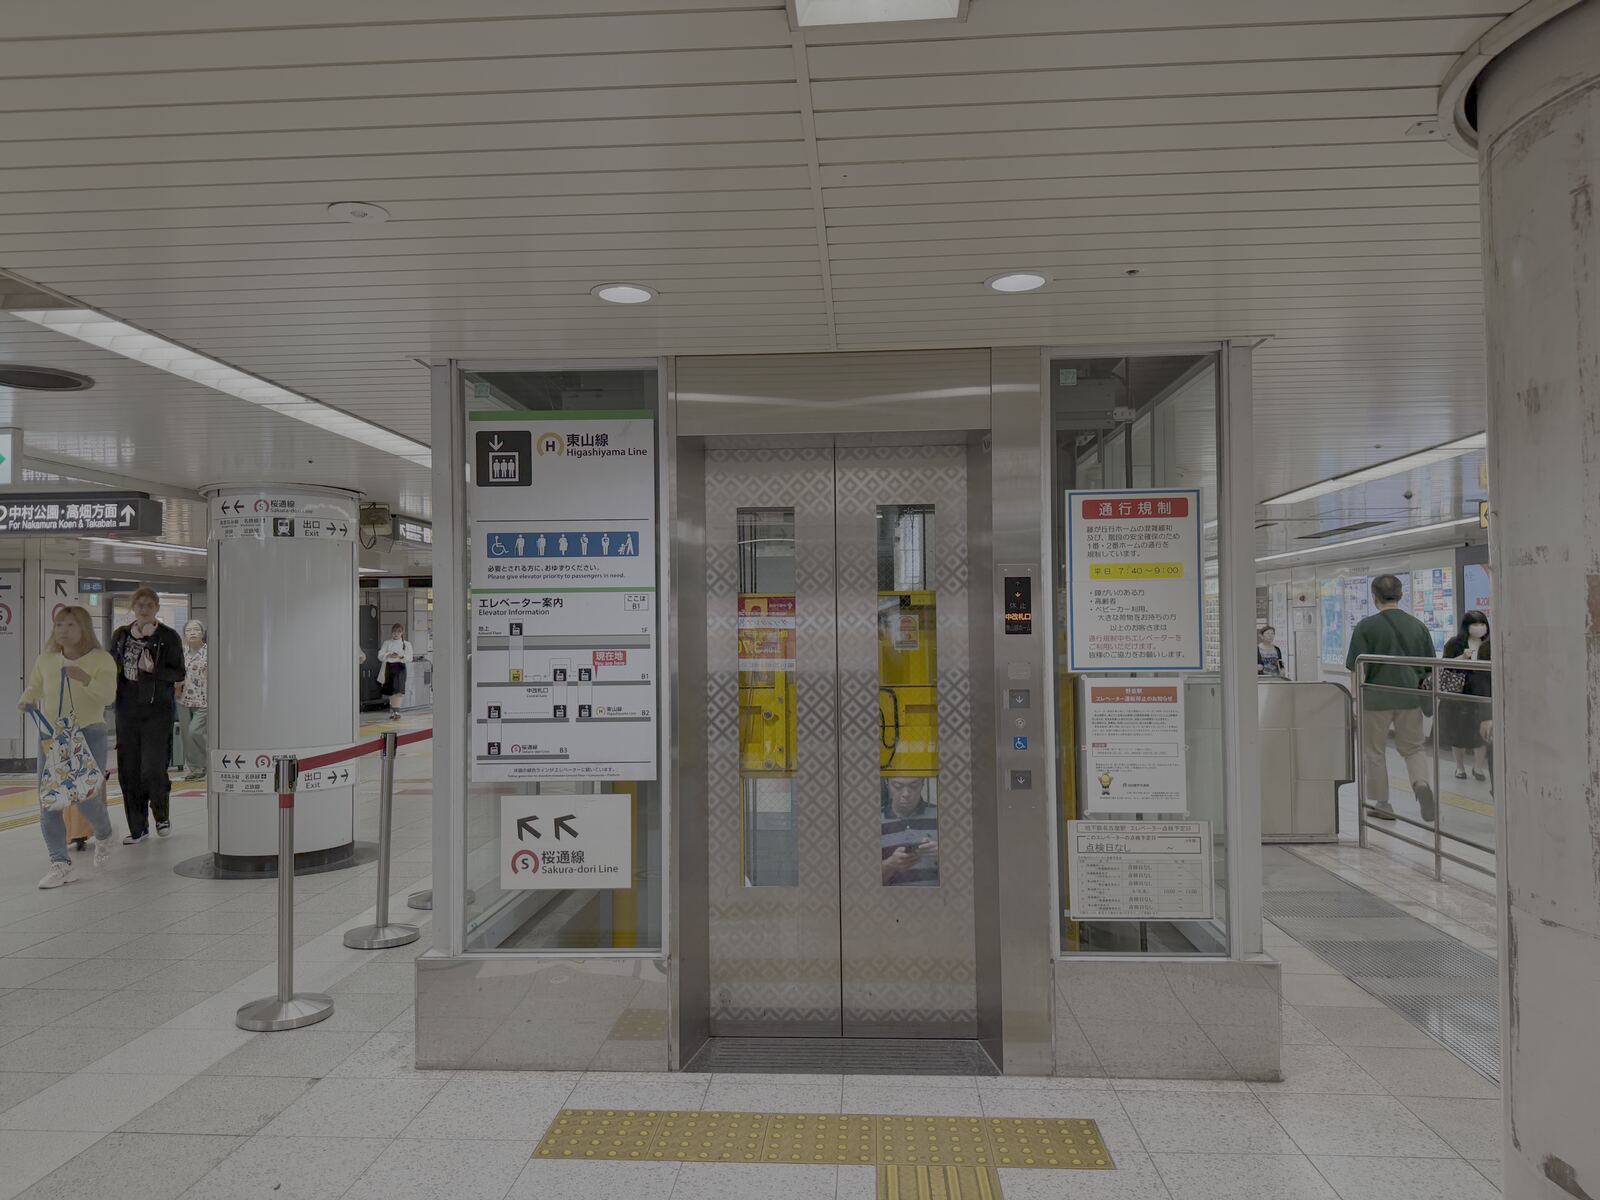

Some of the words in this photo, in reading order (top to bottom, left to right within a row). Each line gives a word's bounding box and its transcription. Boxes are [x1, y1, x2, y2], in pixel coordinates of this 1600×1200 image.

[566, 433, 609, 448] 東山線
[545, 440, 556, 452] H
[566, 448, 626, 459] Higashiyama
[627, 447, 648, 456] Line
[270, 500, 295, 508] 桜通線
[1099, 501, 1172, 516] 通行規制
[9, 503, 118, 520] 中村公園・高畑方面
[9, 519, 21, 529] For
[22, 519, 58, 529] Nakamura
[58, 519, 77, 528] Koen
[78, 519, 84, 528] &
[85, 518, 117, 528] Takabata
[303, 520, 321, 529] 出口
[304, 529, 320, 537] Exit
[1087, 550, 1141, 558] 規制しています。
[487, 564, 600, 573] 必要とされる方に、おゆずりください。
[1095, 567, 1112, 576] 平日
[542, 573, 564, 581] priority
[479, 597, 564, 609] エレベーター案内
[508, 608, 550, 616] Information
[1005, 613, 1031, 621] 中改札口
[596, 651, 624, 661] 現在地
[260, 758, 266, 766] S
[304, 772, 322, 781] 出口
[306, 781, 320, 790] Exit
[1086, 842, 1131, 853] 点検日なし
[541, 850, 585, 865] 桜通線
[521, 858, 529, 870] S
[541, 864, 596, 875] Sakura-dori
[598, 864, 619, 873] Line
